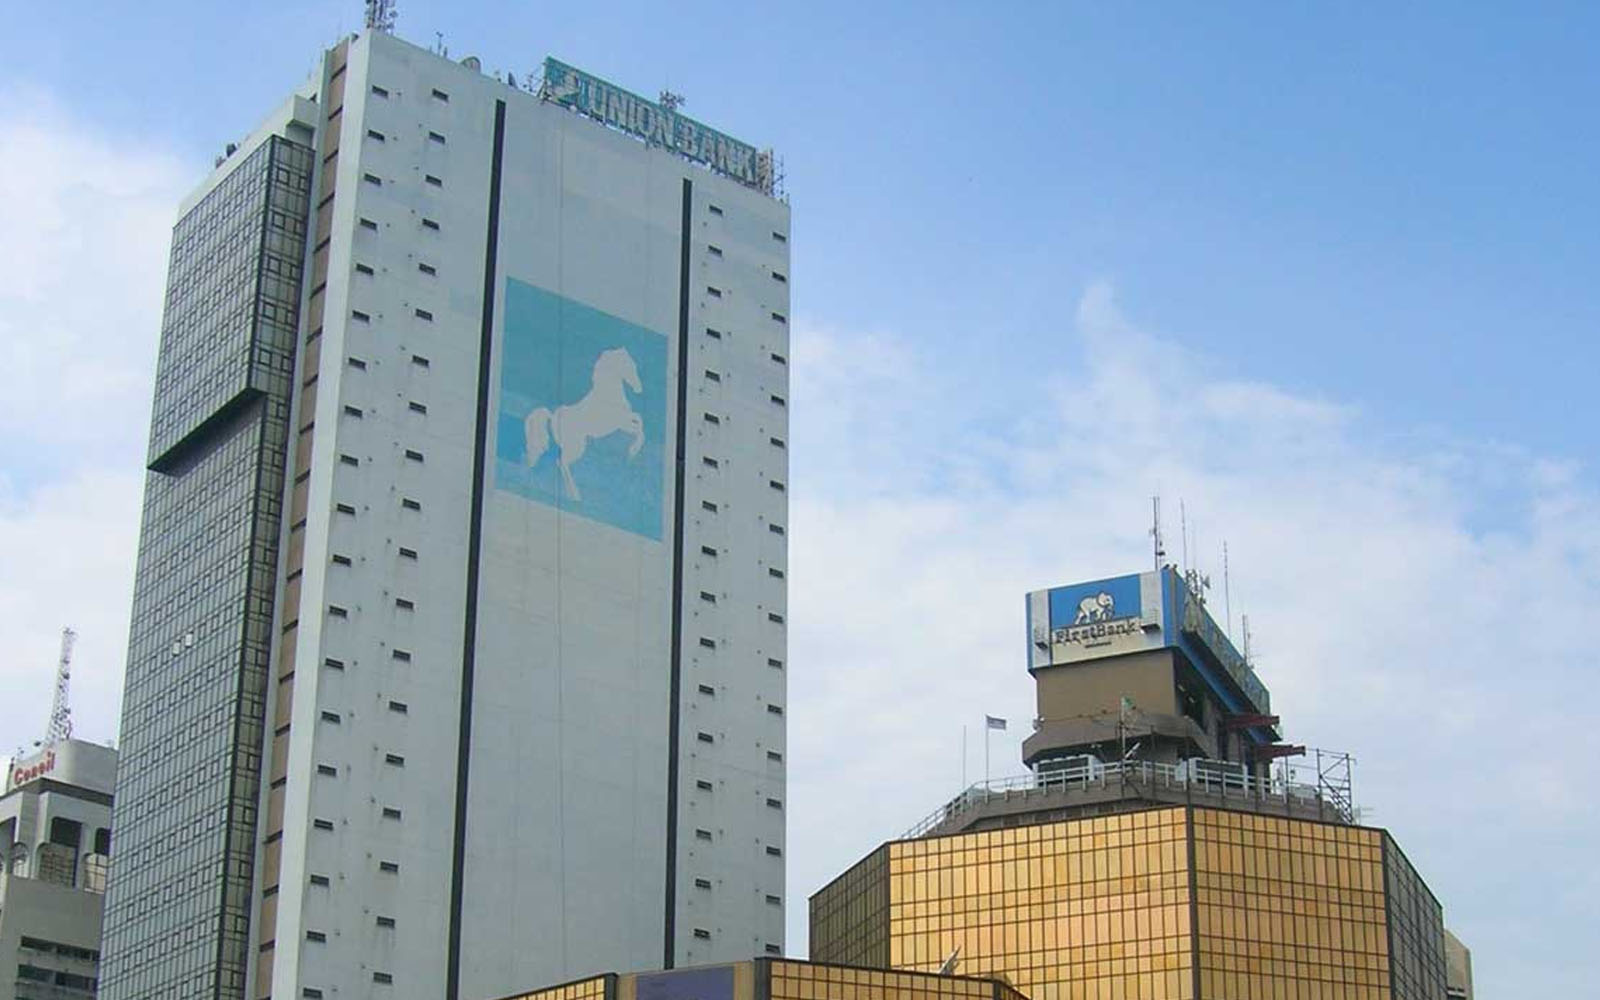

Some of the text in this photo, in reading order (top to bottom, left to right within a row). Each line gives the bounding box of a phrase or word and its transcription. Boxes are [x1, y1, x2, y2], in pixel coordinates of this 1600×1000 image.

[587, 78, 756, 183] UNION BANK
[1053, 619, 1138, 645] FirstBank
